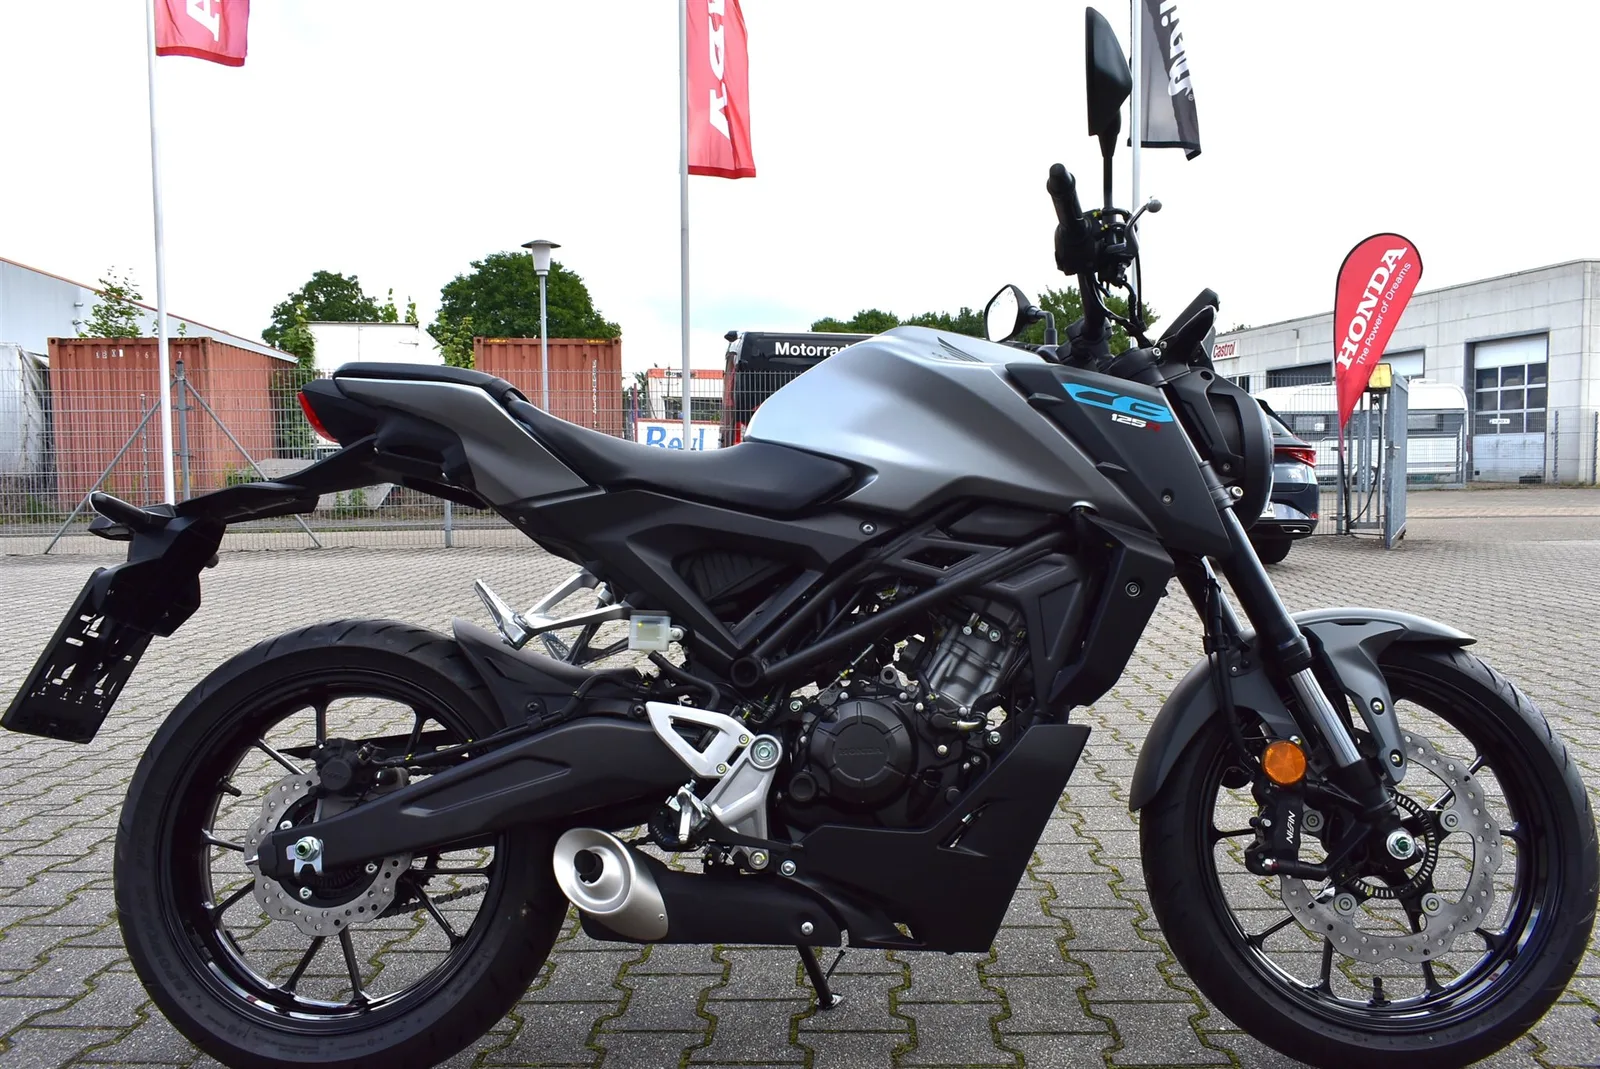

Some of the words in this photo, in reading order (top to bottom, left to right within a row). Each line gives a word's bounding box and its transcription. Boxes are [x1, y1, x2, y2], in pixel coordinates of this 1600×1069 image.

[1213, 341, 1236, 359] Castrol
[1336, 247, 1408, 370] HONDA
[1356, 347, 1370, 365] The
[1365, 312, 1384, 347] Power
[1380, 300, 1389, 314] of
[1385, 262, 1412, 301] Dreams
